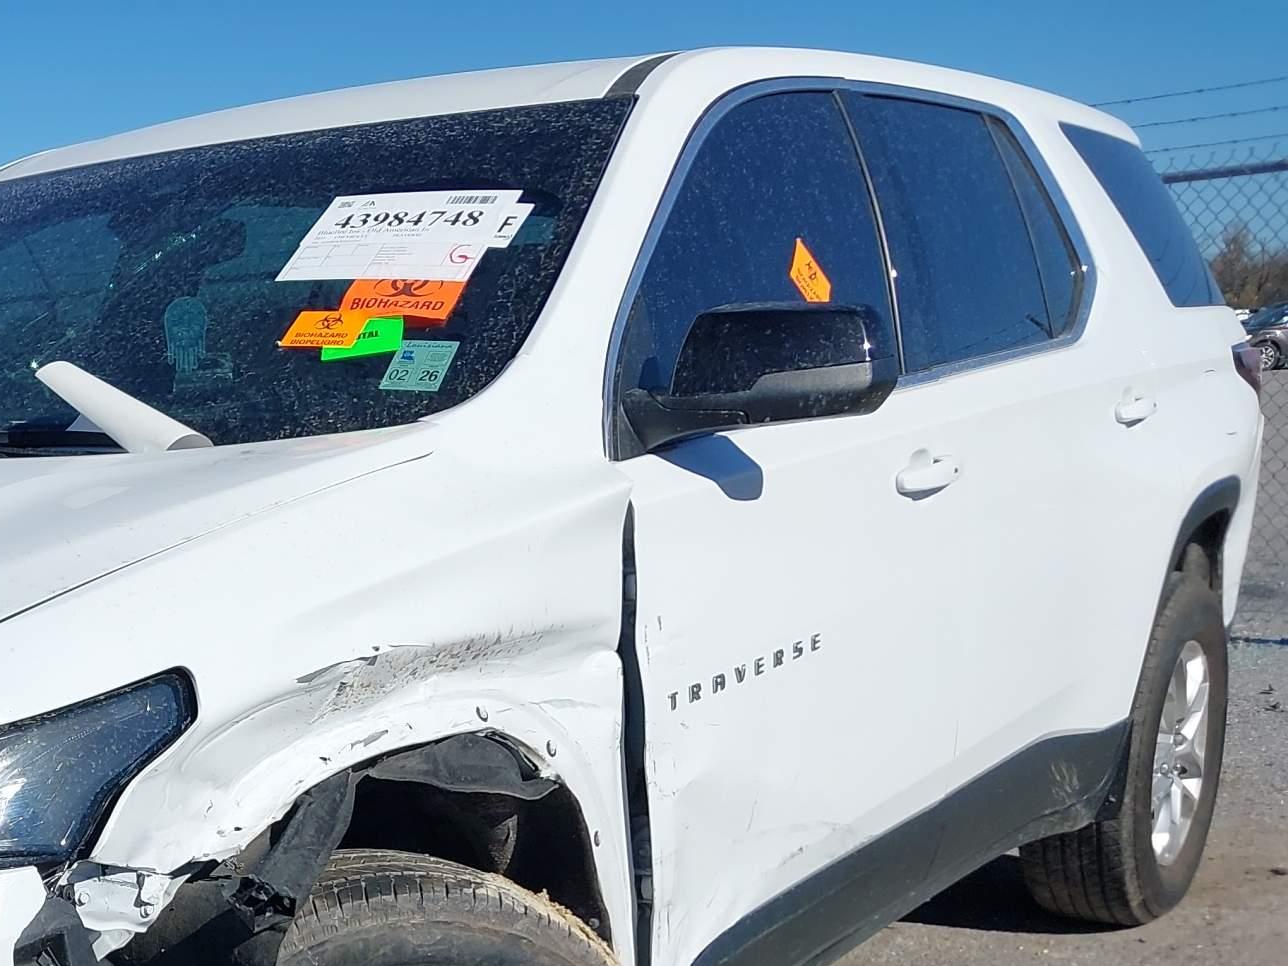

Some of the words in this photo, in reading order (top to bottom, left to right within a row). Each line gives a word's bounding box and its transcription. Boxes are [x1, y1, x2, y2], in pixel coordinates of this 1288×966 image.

[334, 210, 484, 229] 43984748
[497, 215, 518, 233] F
[350, 297, 445, 311] BIOHAZARD
[389, 369, 409, 381] 02
[418, 370, 440, 382] 26
[667, 632, 822, 712] TRAVERSE
